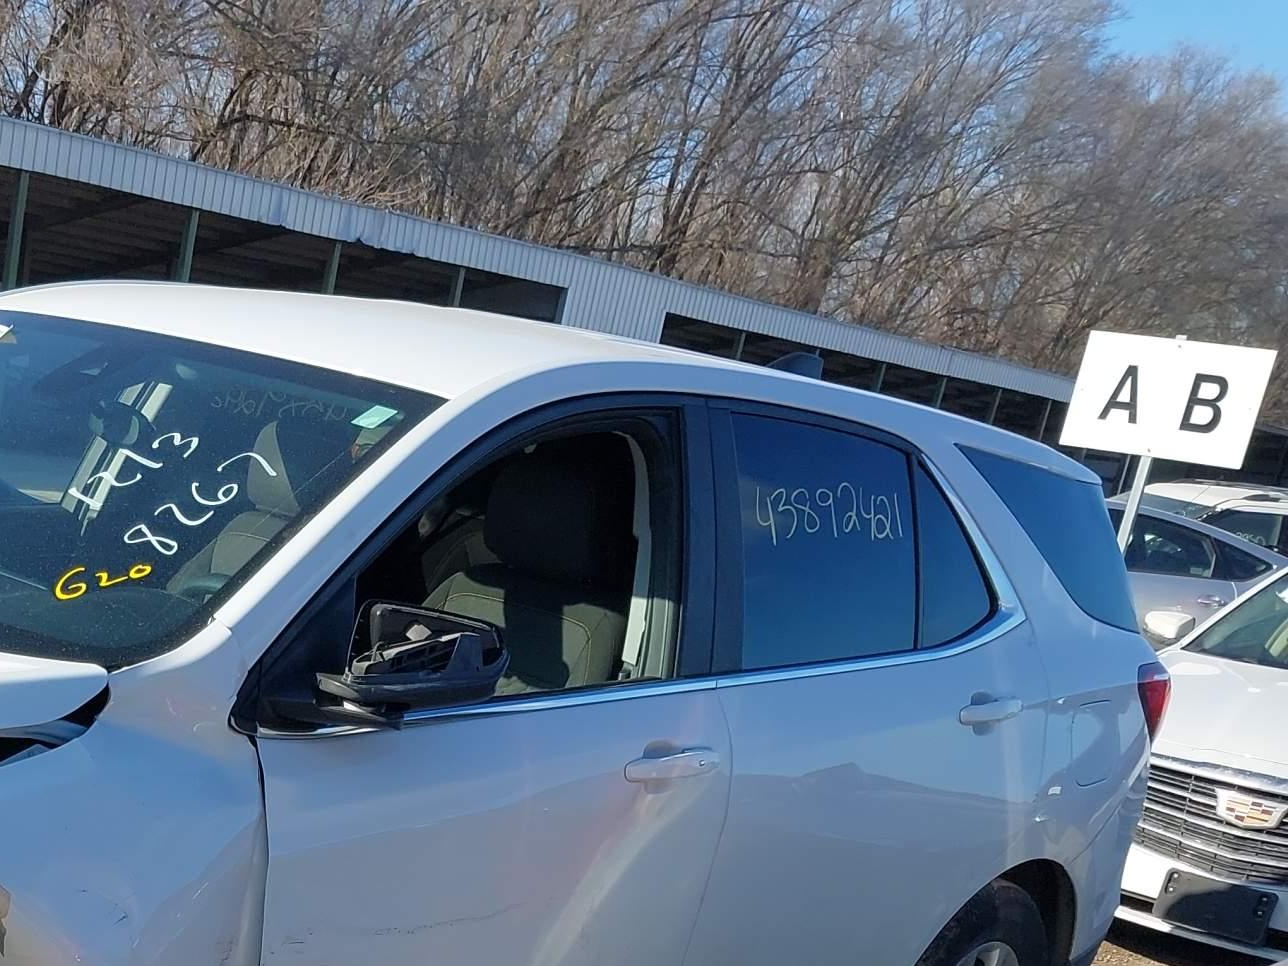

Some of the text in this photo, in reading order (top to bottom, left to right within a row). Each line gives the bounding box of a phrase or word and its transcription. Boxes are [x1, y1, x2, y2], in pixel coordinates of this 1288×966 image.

[1097, 365, 1229, 434] A B
[123, 452, 278, 556] 8267
[755, 482, 904, 547] 43892421
